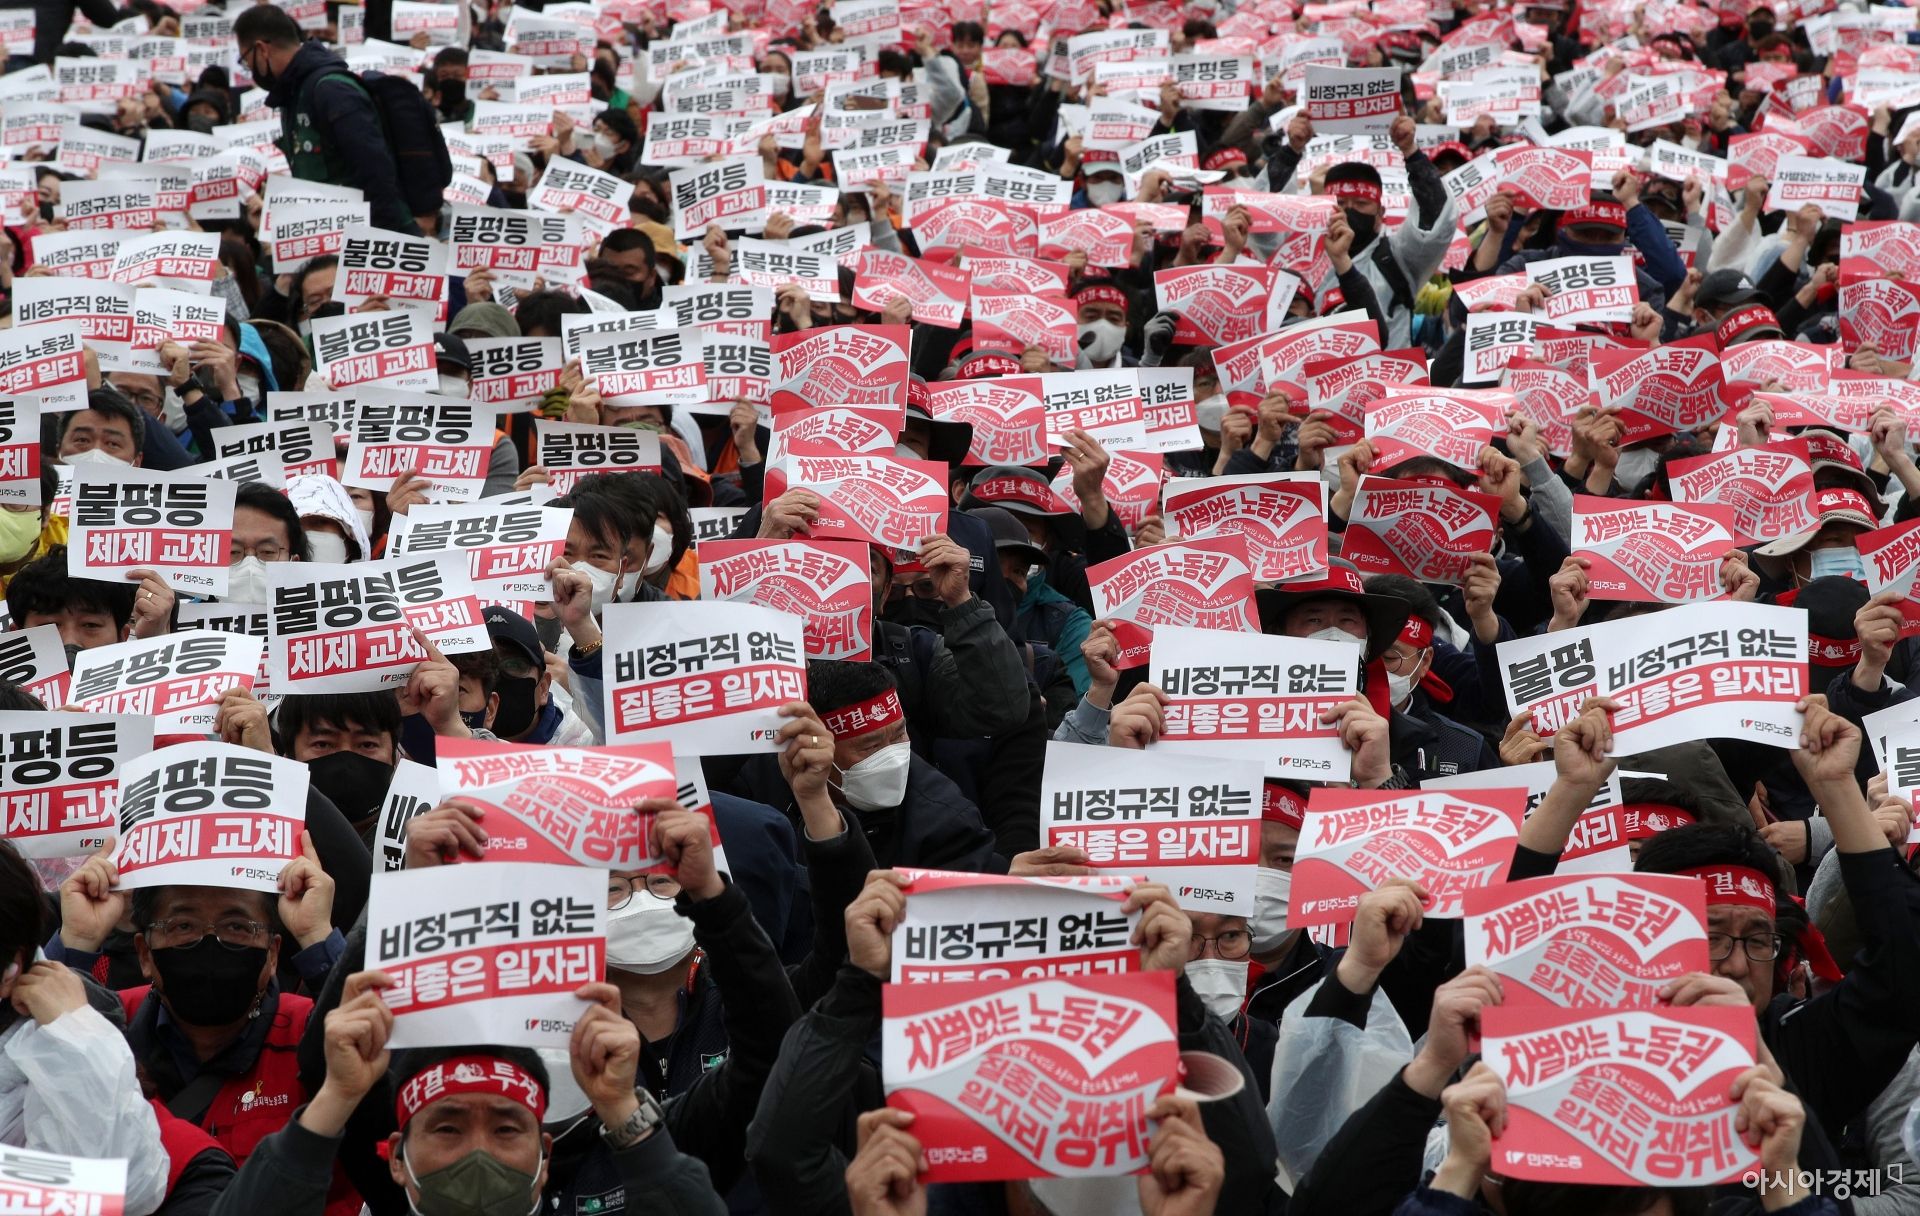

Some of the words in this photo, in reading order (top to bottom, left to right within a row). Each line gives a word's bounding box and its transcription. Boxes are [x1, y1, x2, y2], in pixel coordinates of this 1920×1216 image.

[1178, 60, 1240, 83] 불평등
[1442, 47, 1491, 75] 불평등
[650, 117, 712, 142] 불평등
[861, 122, 917, 148] 불평등
[545, 166, 619, 200] 불평등
[677, 163, 747, 210] 불평등
[908, 175, 976, 201] 불평등
[984, 176, 1057, 203] 불평등
[66, 195, 122, 217] 비정규직
[124, 194, 151, 208] 없는
[542, 189, 578, 207] 체제
[578, 198, 615, 220] 교체
[686, 202, 715, 231] 체제
[721, 190, 759, 214] 교체
[453, 216, 529, 245] 불평등
[117, 243, 177, 269] 비정규직
[181, 242, 214, 259] 없는
[343, 238, 430, 273] 불평등
[457, 247, 490, 267] 체제
[495, 248, 534, 269] 교체
[743, 251, 820, 278] 불평등
[346, 272, 385, 296] 체제
[393, 275, 436, 299] 교체
[1164, 274, 1208, 303] 차별없는
[1211, 272, 1255, 300] 노동권
[1547, 295, 1590, 318] 체제
[1593, 287, 1633, 309] 교체
[1842, 286, 1872, 311] 차별없는
[1873, 283, 1913, 316] 노동권
[19, 296, 91, 322] 비정규직
[96, 295, 129, 315] 없는
[186, 305, 219, 322] 없는
[669, 290, 754, 326] 불평등
[25, 333, 75, 361] 노동권
[319, 315, 413, 365] 불평등
[586, 333, 682, 373] 불평등
[779, 336, 830, 381] 차별없는
[833, 331, 894, 371] 노동권
[332, 357, 379, 387] 체제
[383, 347, 429, 373] 교체
[963, 362, 984, 377] 단결
[1605, 358, 1654, 401] 차별없는
[1653, 350, 1704, 379] 노동권
[1728, 345, 1768, 375] 차별없는
[1771, 341, 1814, 364] 노동권
[601, 374, 646, 396] 체제
[652, 366, 698, 389] 교체
[1093, 383, 1133, 402] 없는
[1154, 382, 1188, 402] 없는
[1510, 371, 1550, 393] 차별없는
[1551, 376, 1590, 410] 노동권
[357, 405, 474, 444] 불평등
[825, 409, 885, 452] 노동권
[1082, 403, 1137, 426] 일자리
[1373, 400, 1426, 430] 차별없는
[1428, 399, 1480, 428] 노동권
[542, 432, 640, 466] 불평등
[988, 426, 1036, 458] 쟁취!
[363, 446, 416, 475] 체제
[422, 449, 482, 477] 교체
[797, 457, 862, 482] 차별없는
[865, 459, 930, 496] 노동권
[1679, 461, 1735, 503] 차별없는
[1738, 454, 1794, 492] 노동권
[75, 482, 209, 528] 불평등
[983, 480, 1016, 496] 단결
[1173, 496, 1237, 537] 차별없는
[1239, 491, 1304, 528] 노동권
[1363, 491, 1424, 519] 차별없는
[1427, 491, 1481, 532] 노동권
[1583, 510, 1648, 544] 차별없는
[1651, 508, 1716, 550] 노동권
[88, 532, 152, 565] 체제
[160, 531, 220, 566] 교체
[407, 510, 543, 553] 불평등
[1394, 514, 1435, 554] 질좋은
[488, 543, 552, 577] 교체
[1261, 551, 1315, 579] 쟁취!
[1361, 552, 1390, 566] 민주노총
[1621, 534, 1671, 574] 질좋은
[183, 573, 215, 588] 민주노총
[513, 582, 546, 593] 민주노총
[710, 548, 780, 600] 차별없는
[784, 546, 850, 591] 노동권
[1101, 557, 1163, 613] 차별없는
[1163, 553, 1230, 589] 노동권
[1593, 579, 1627, 591] 민주노총
[1611, 547, 1662, 592] 일자리
[1663, 563, 1718, 601] 쟁취!
[274, 575, 402, 636] 불평등
[441, 636, 475, 648] 민주노총
[802, 614, 859, 654] 쟁취!
[75, 637, 228, 703] 불평등
[614, 632, 740, 683] 비정규직
[746, 631, 797, 664] 없는
[1607, 632, 1730, 693] 비정규직
[1737, 627, 1798, 660] 없는
[620, 682, 714, 727] 질좋은
[721, 667, 803, 703] 일자리
[1161, 664, 1281, 696] 비정규직
[1287, 663, 1347, 693] 없는
[1612, 675, 1703, 725] 질좋은
[1710, 666, 1800, 698] 일자리
[827, 704, 865, 737] 단결
[1753, 720, 1793, 737] 민주노총
[454, 754, 550, 789] 차별없는
[552, 752, 649, 787] 노동권
[1291, 757, 1332, 770] 민주노총
[120, 757, 274, 835] 불평등
[1054, 787, 1180, 822] 비정규직
[1188, 784, 1252, 816] 없는
[119, 823, 199, 867] 체제
[210, 817, 292, 855] 교체
[1314, 802, 1410, 849] 차별없는
[1413, 800, 1501, 848] 노동권
[1565, 811, 1618, 850] 자리
[1193, 887, 1235, 903] 민주노총
[379, 901, 520, 961] 비정규직
[530, 897, 595, 937] 없는
[906, 918, 1047, 961] 비정규직
[1058, 911, 1129, 952] 없는
[1481, 891, 1581, 960] 차별없는
[1587, 886, 1681, 948] 노동권
[380, 955, 485, 1006] 질좋은
[496, 944, 596, 990] 일자리
[1542, 940, 1623, 993] 질좋은
[904, 998, 1021, 1074] 차별없는
[1029, 992, 1142, 1060] 노동권
[1502, 1027, 1611, 1088] 차별없는
[1616, 1022, 1723, 1082] 노동권
[402, 1069, 445, 1111] 단결
[975, 1055, 1063, 1120] 질좋은
[1568, 1075, 1653, 1134] 질좋은
[929, 1148, 988, 1164] 민주노총
[1553, 1099, 1638, 1170] 일자리
[1644, 1112, 1739, 1180] 쟁취!
[1526, 1153, 1583, 1169] 민주노총
